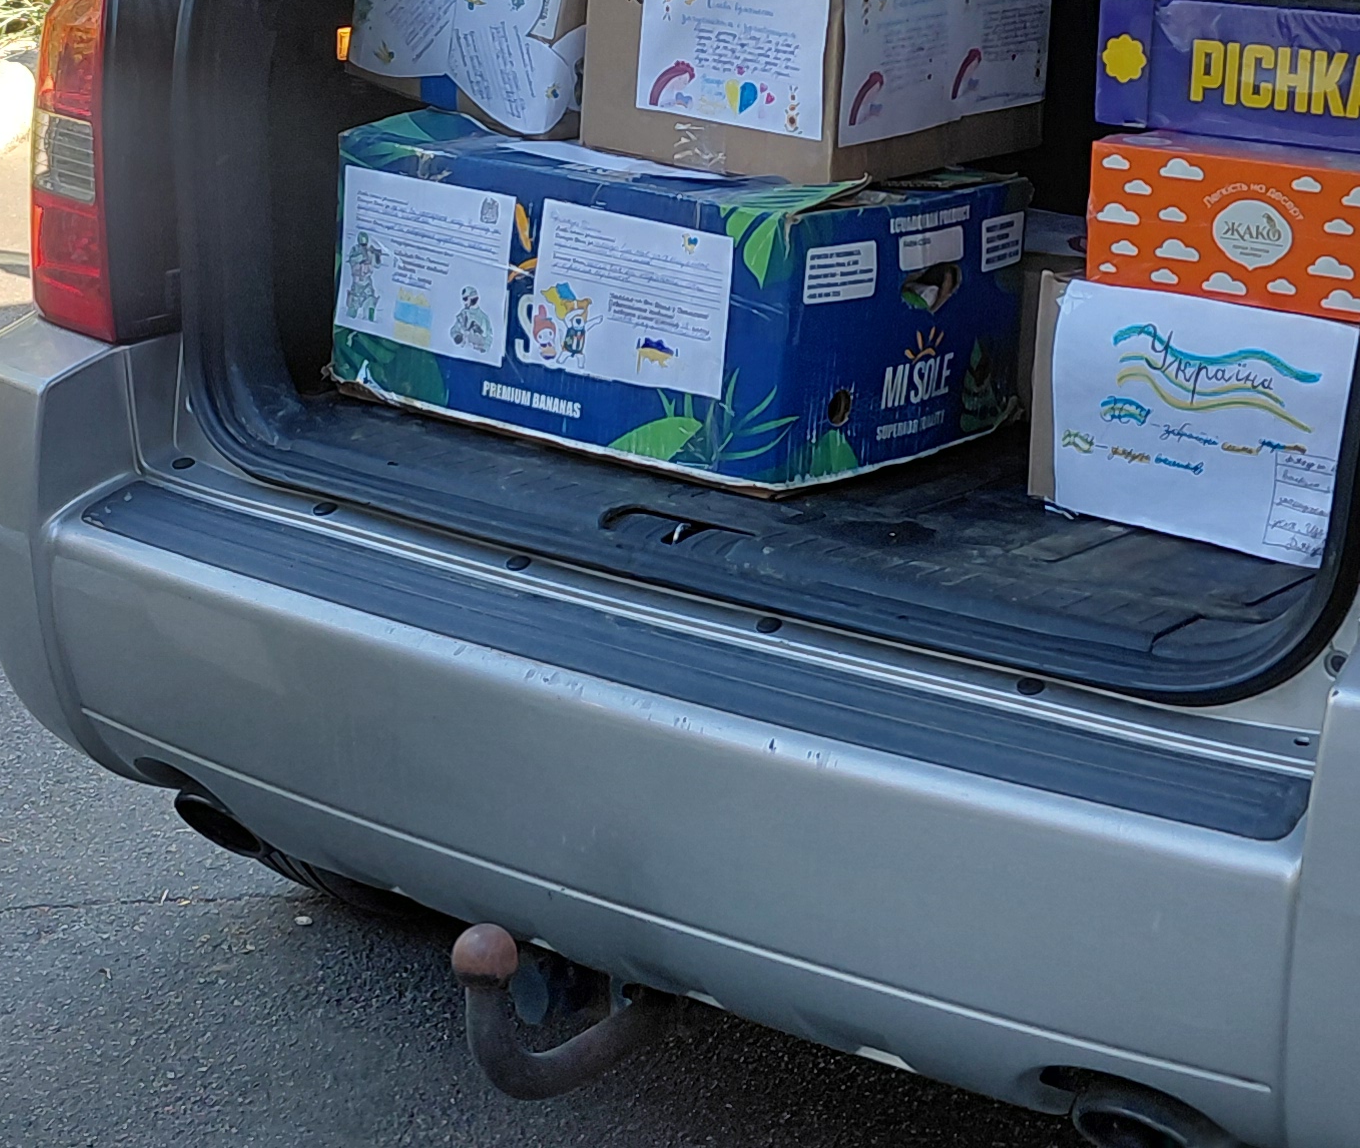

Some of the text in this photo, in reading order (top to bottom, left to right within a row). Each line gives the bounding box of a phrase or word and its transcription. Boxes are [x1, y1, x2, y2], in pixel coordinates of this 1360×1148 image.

[1249, 183, 1266, 193] на
[1266, 187, 1304, 221] десерт
[1222, 220, 1282, 242] ЖАКО
[880, 352, 954, 409] MI SOLE
[1138, 323, 1275, 406] Україна
[482, 380, 581, 419] PREMIUM BANANAS
